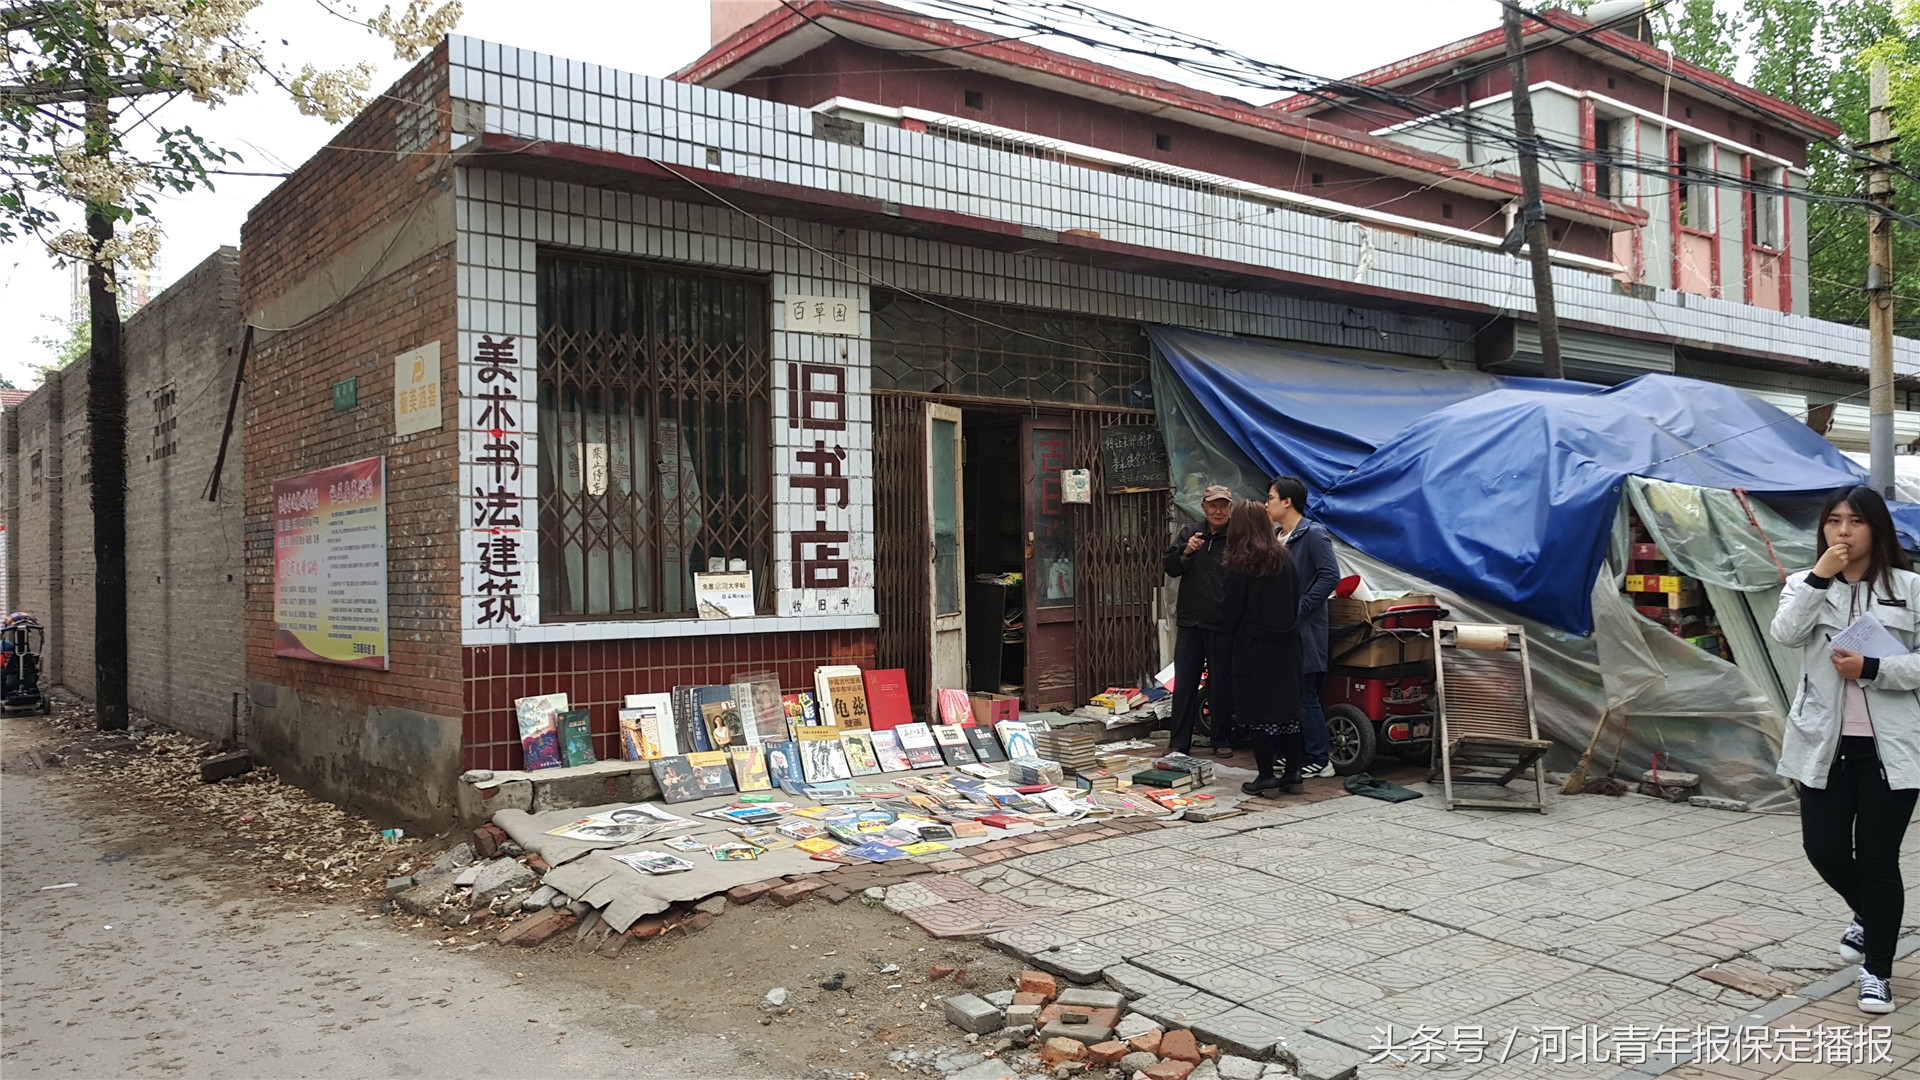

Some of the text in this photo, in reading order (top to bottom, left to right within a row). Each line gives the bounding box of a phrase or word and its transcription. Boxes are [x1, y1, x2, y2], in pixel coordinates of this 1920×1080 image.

[793, 301, 846, 323] 百草园
[788, 362, 849, 588] 旧书店
[793, 598, 849, 612] 收旧书
